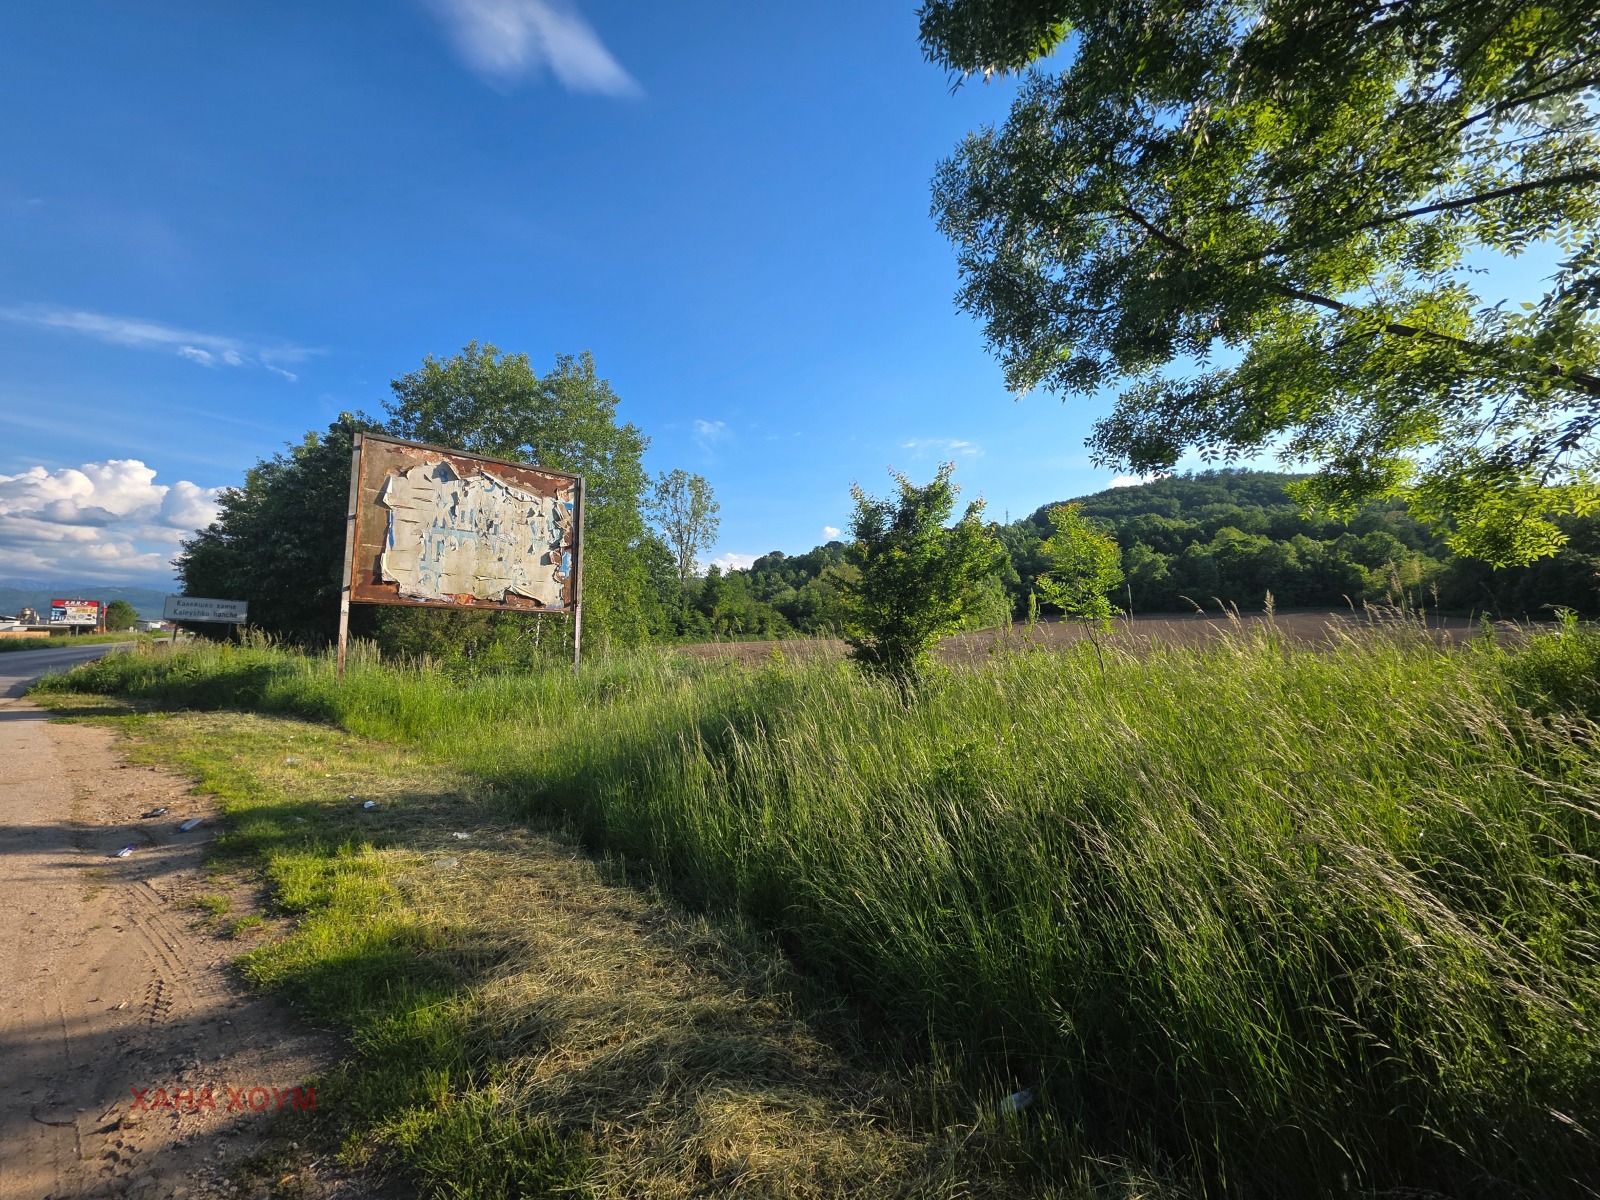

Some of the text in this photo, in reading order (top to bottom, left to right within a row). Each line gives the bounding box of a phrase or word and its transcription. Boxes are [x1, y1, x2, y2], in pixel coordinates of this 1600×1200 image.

[176, 600, 237, 610] Калейшко ханче
[173, 608, 238, 618] Kaleyshko hanche
